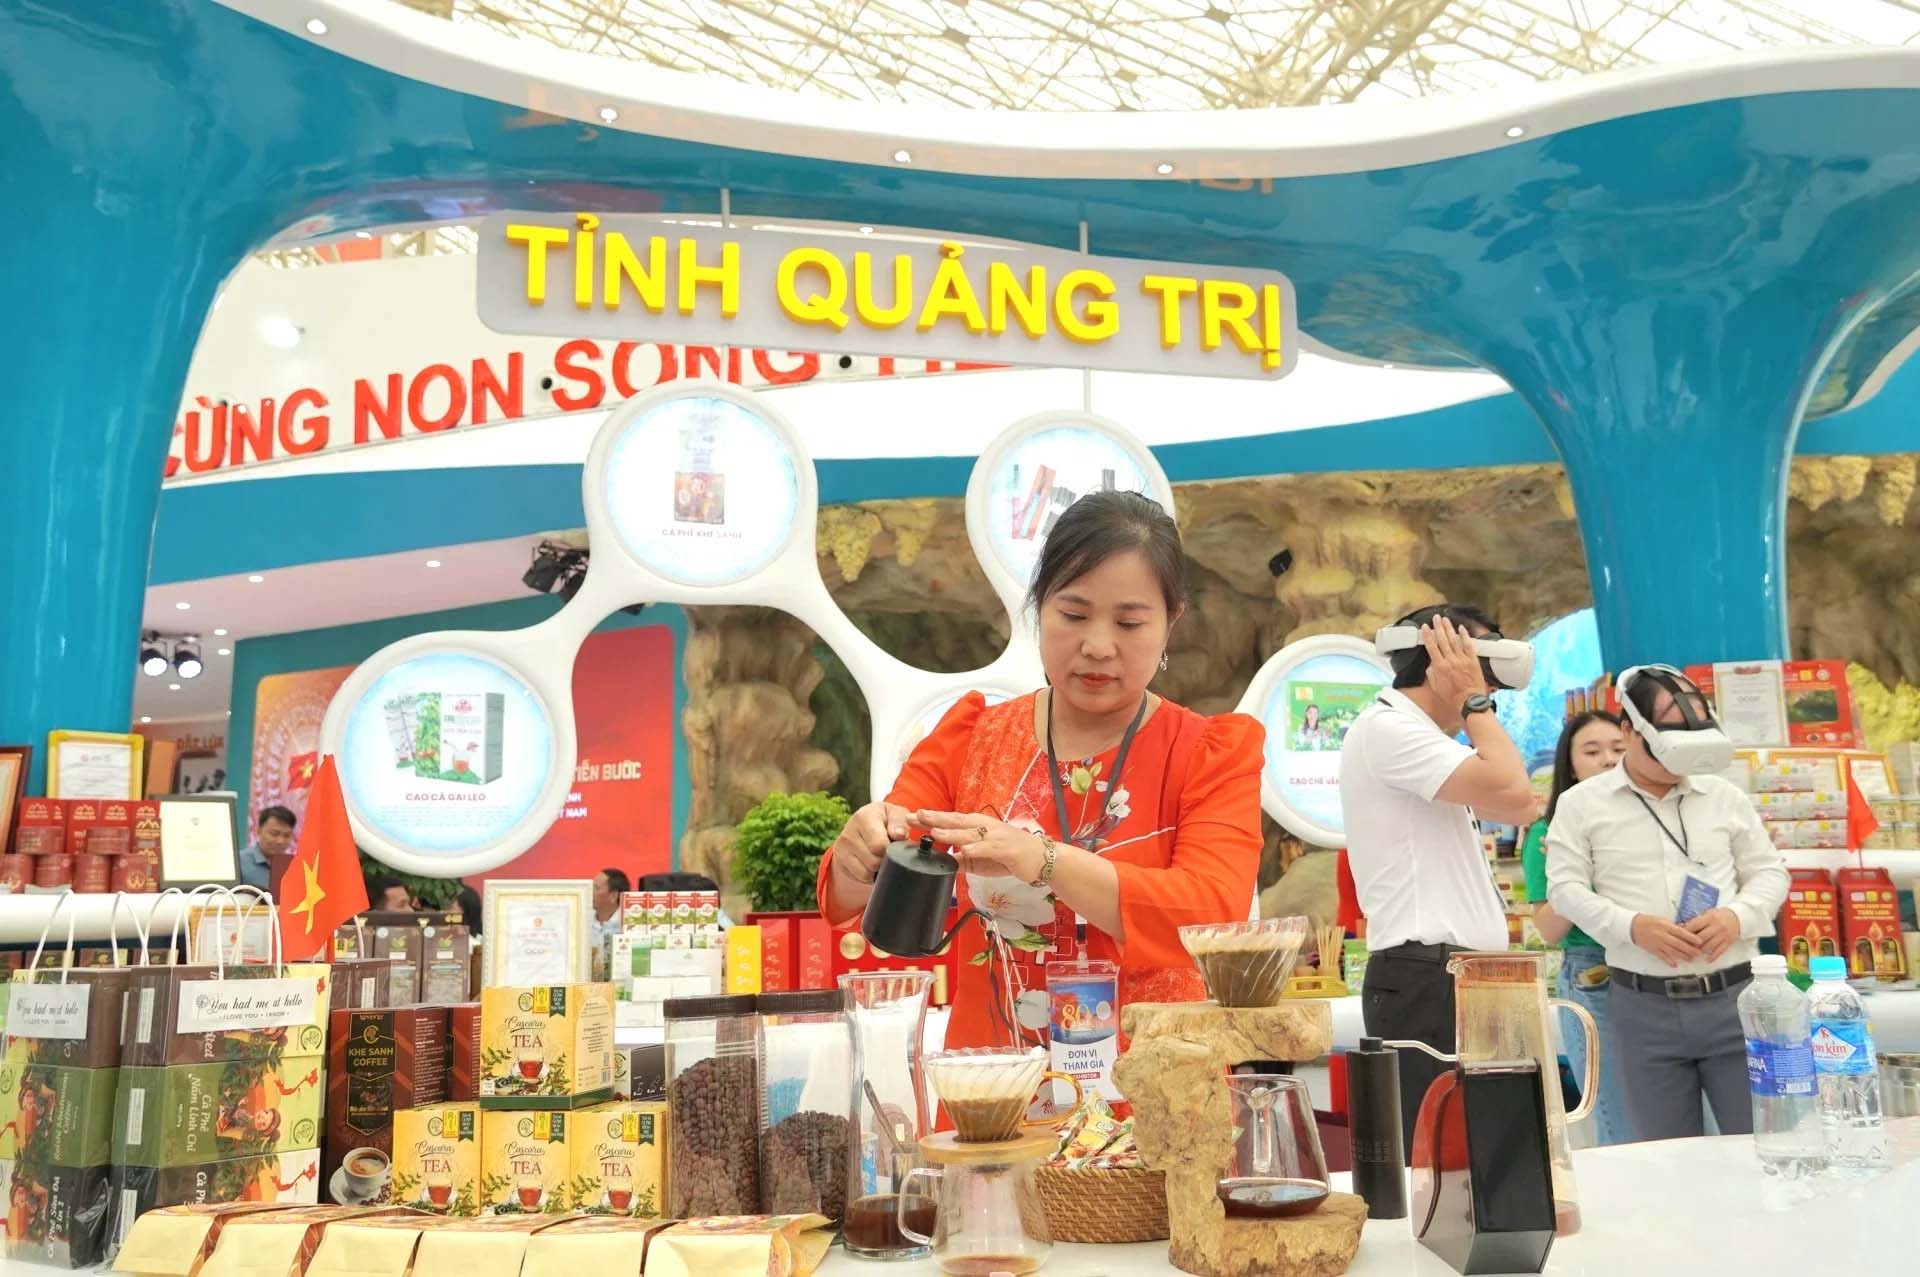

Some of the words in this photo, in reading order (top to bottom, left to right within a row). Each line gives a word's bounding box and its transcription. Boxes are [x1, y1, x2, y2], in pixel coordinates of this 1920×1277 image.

[506, 212, 740, 319] TỈNH
[776, 241, 1120, 342] QUẢNG
[1143, 274, 1281, 372] TRỊ
[354, 351, 525, 460] NON
[405, 792, 430, 802] CAO
[233, 997, 251, 1010] had
[284, 993, 303, 1007] hello
[506, 1016, 546, 1032] Cascara
[511, 1034, 543, 1048] TEA
[348, 1047, 367, 1056] KHE
[368, 1047, 393, 1056] SANH
[353, 1057, 389, 1066] COFFEE
[1063, 1061, 1088, 1071] THAM
[1090, 1059, 1105, 1069] GIA
[415, 1142, 455, 1157] Cascara
[504, 1142, 545, 1159] Cascara
[594, 1143, 635, 1160] Cascara
[421, 1160, 451, 1173] TEA
[511, 1161, 542, 1175] TEA
[601, 1163, 632, 1177] TEA
[196, 1171, 207, 1187] Cà
[196, 1189, 206, 1204] Ph
